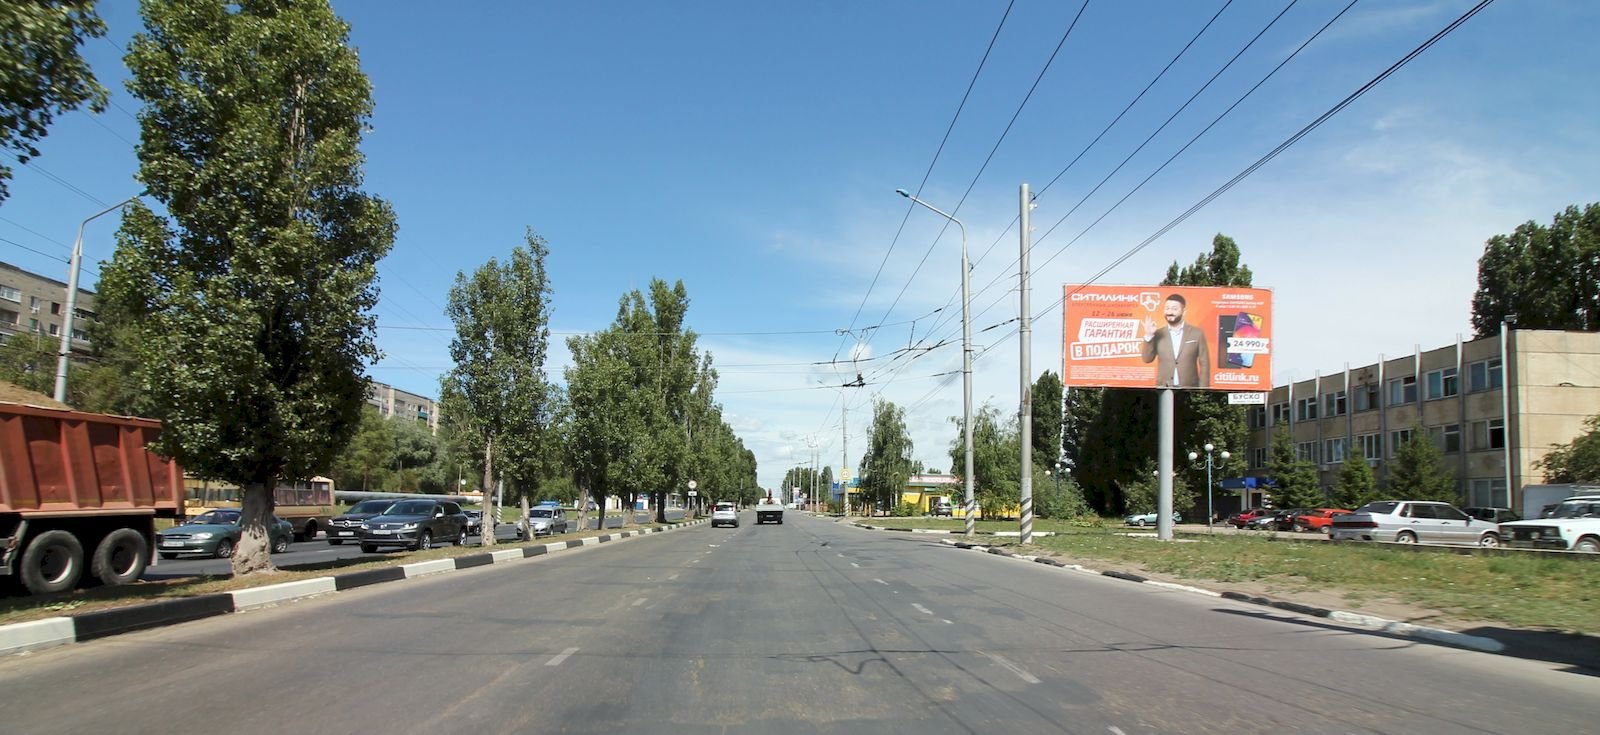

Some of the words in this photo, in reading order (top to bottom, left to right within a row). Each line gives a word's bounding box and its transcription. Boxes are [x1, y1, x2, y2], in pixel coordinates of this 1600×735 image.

[1071, 293, 1139, 302] СИТИЛИНК
[1084, 321, 1134, 329] РАСШИРЕННАЯ
[1084, 328, 1133, 338] ГАРАНТИЯ
[1075, 345, 1083, 357] В
[1086, 342, 1140, 356] ПОДАРОК
[1214, 372, 1260, 382] citilink.ru
